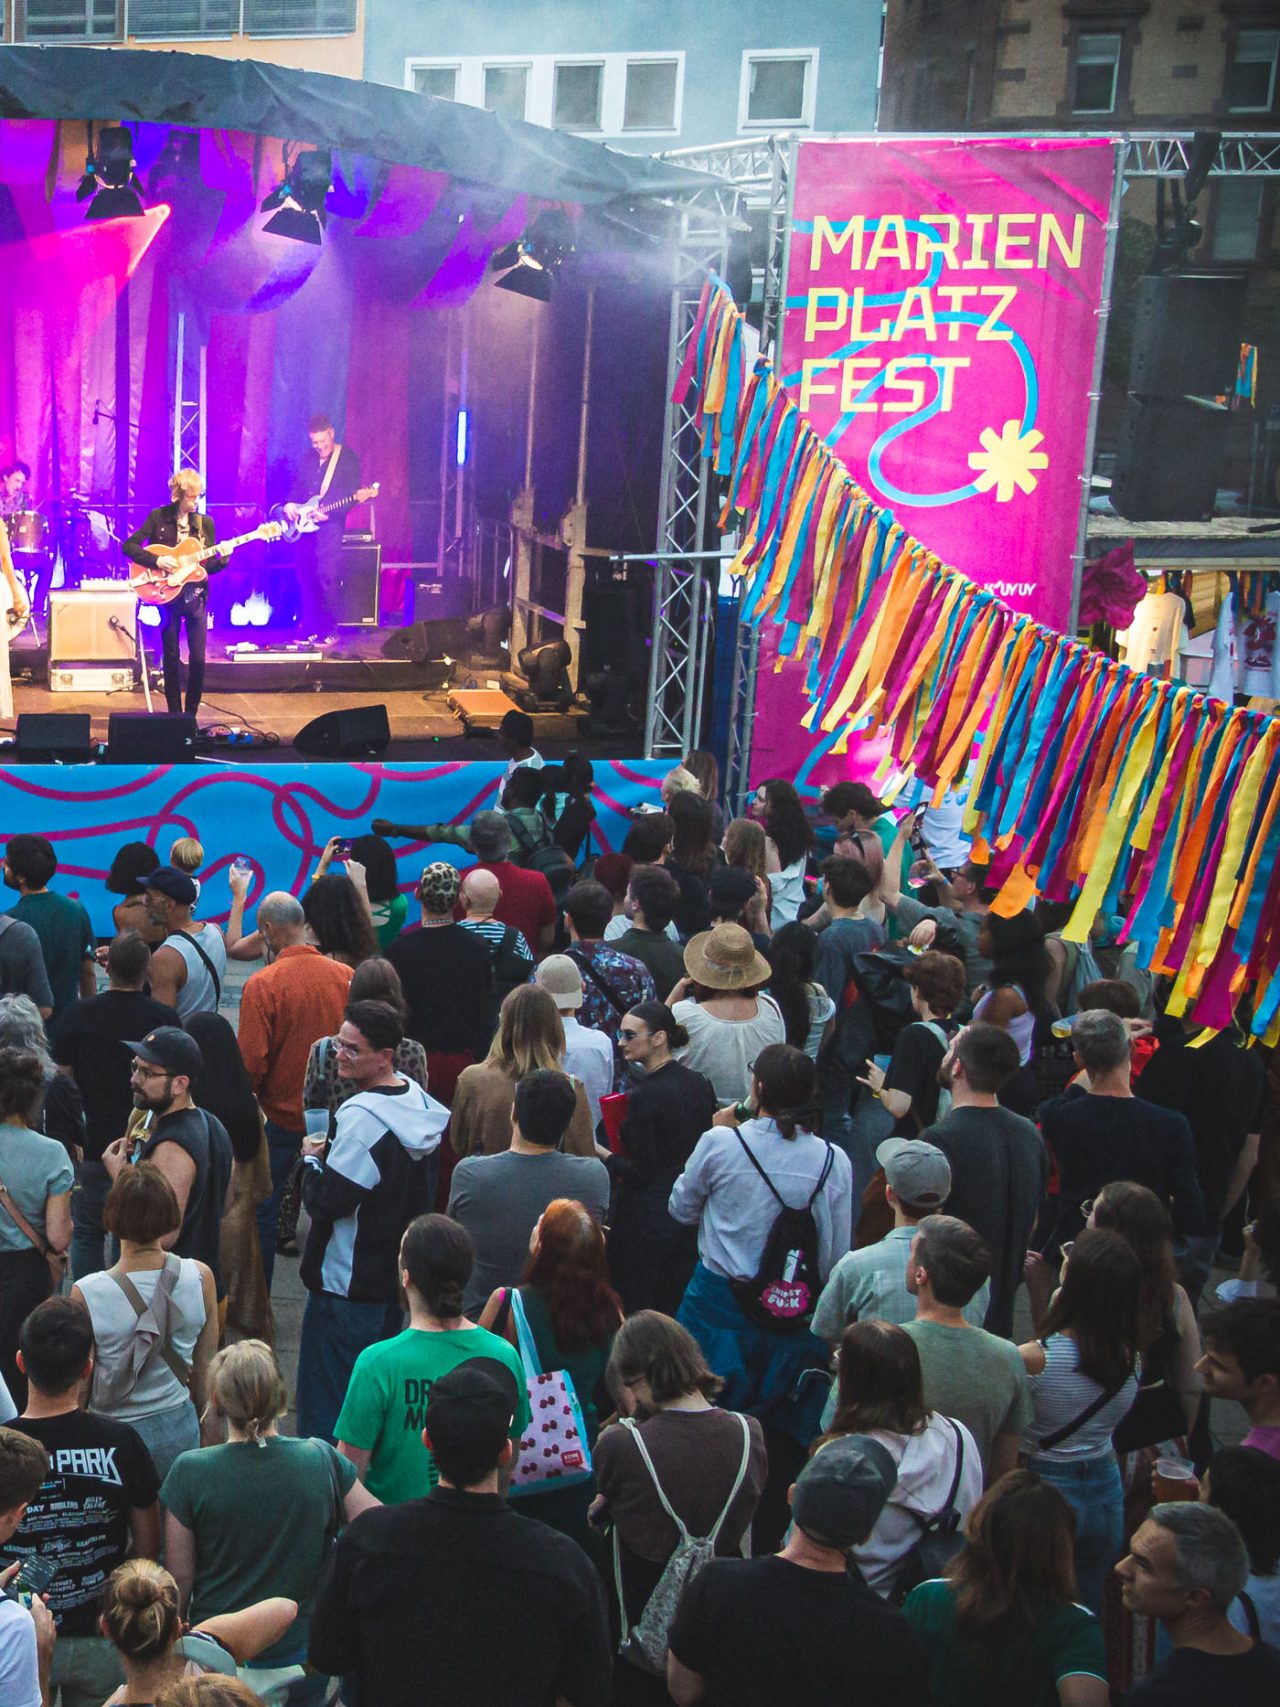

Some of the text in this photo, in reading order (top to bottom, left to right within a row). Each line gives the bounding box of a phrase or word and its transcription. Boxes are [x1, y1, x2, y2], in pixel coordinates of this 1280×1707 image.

[810, 213, 1085, 270] MARIEN
[804, 286, 1017, 341] PLATZ
[799, 357, 970, 412] FEST
[405, 1378, 434, 1405] DR
[56, 1447, 122, 1486] PARK
